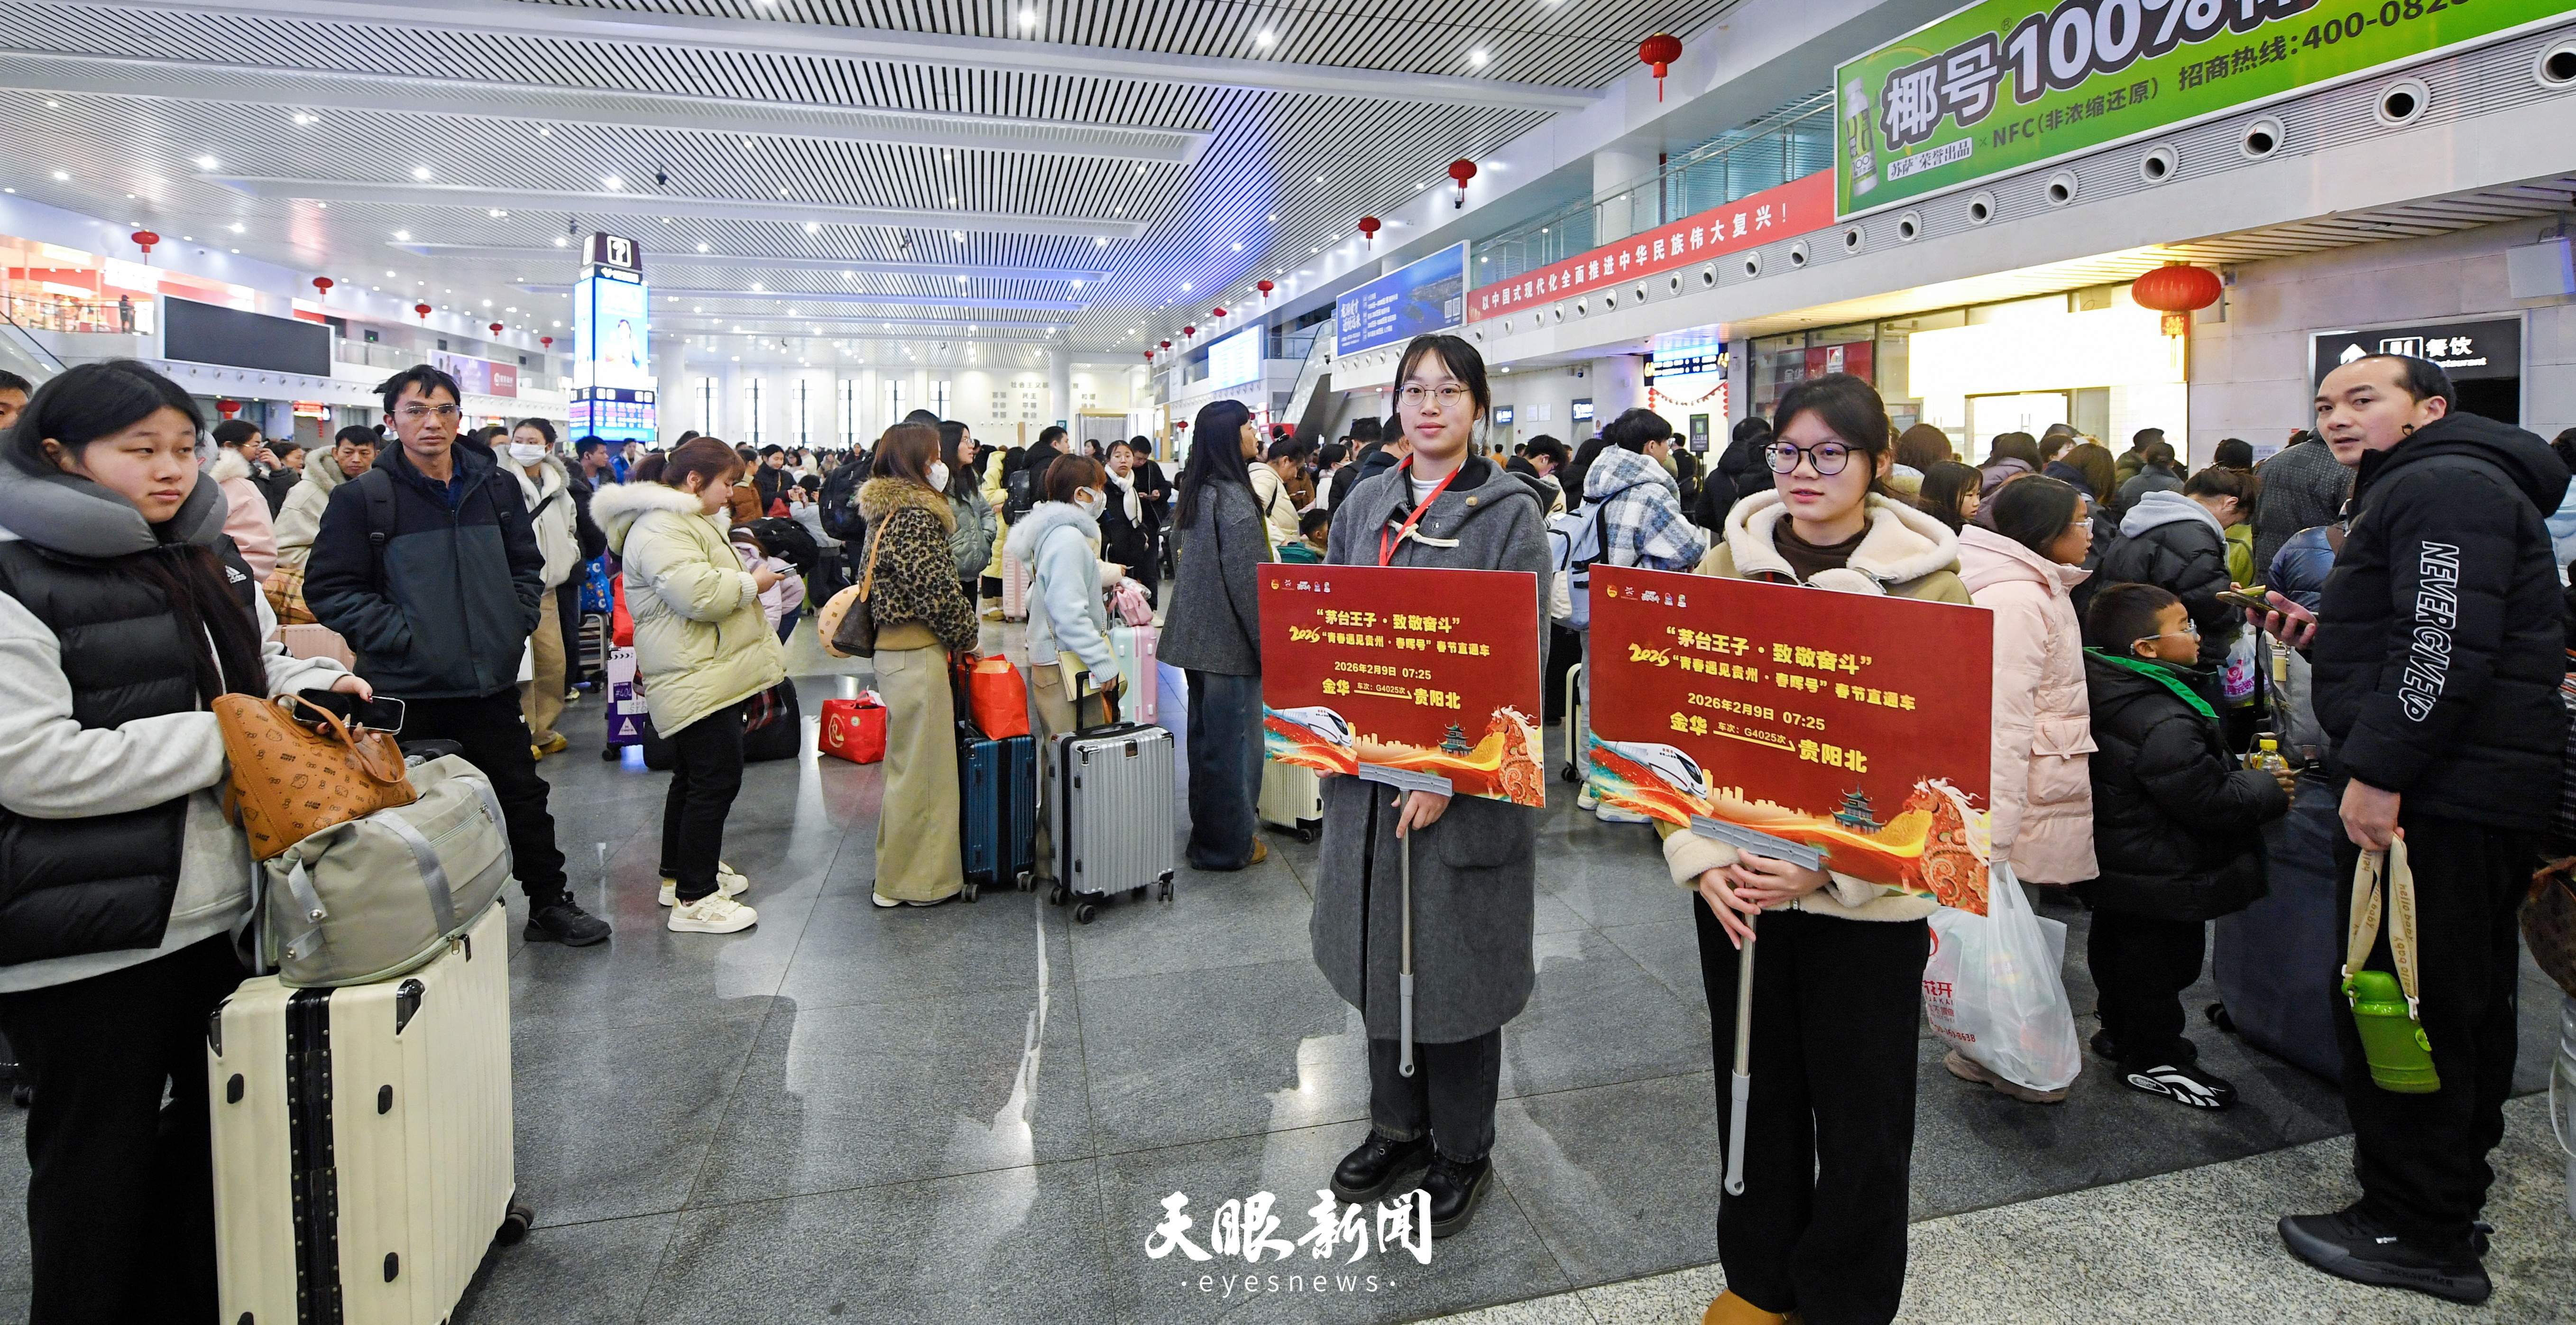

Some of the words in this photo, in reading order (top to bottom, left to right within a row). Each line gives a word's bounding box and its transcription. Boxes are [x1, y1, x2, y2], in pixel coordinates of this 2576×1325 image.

[1482, 202, 1787, 311] 以中国式现代化全面推进中华民族伟大复兴！
[2426, 336, 2473, 357] 餐饮
[1317, 609, 1460, 633] “茅台王子·致敬奋斗”
[1289, 626, 1320, 643] 2026
[1437, 641, 1490, 656] 春节直通车
[1667, 626, 1871, 675] “茅台王子·致敬奋斗”
[1335, 662, 1396, 676] 2026年2月9日
[1402, 668, 1431, 680] 07:25
[1628, 643, 1671, 666] 2026
[1835, 683, 1915, 710] 春节直通车
[1323, 678, 1350, 696] 金华
[1414, 688, 1461, 709] 贵阳北
[1688, 693, 1773, 720] 2026年2月9日
[1783, 712, 1825, 730] 07:25
[1670, 712, 1707, 736] 金华
[1798, 739, 1867, 773] 贵阳北
[1922, 980, 1952, 998] 花开
